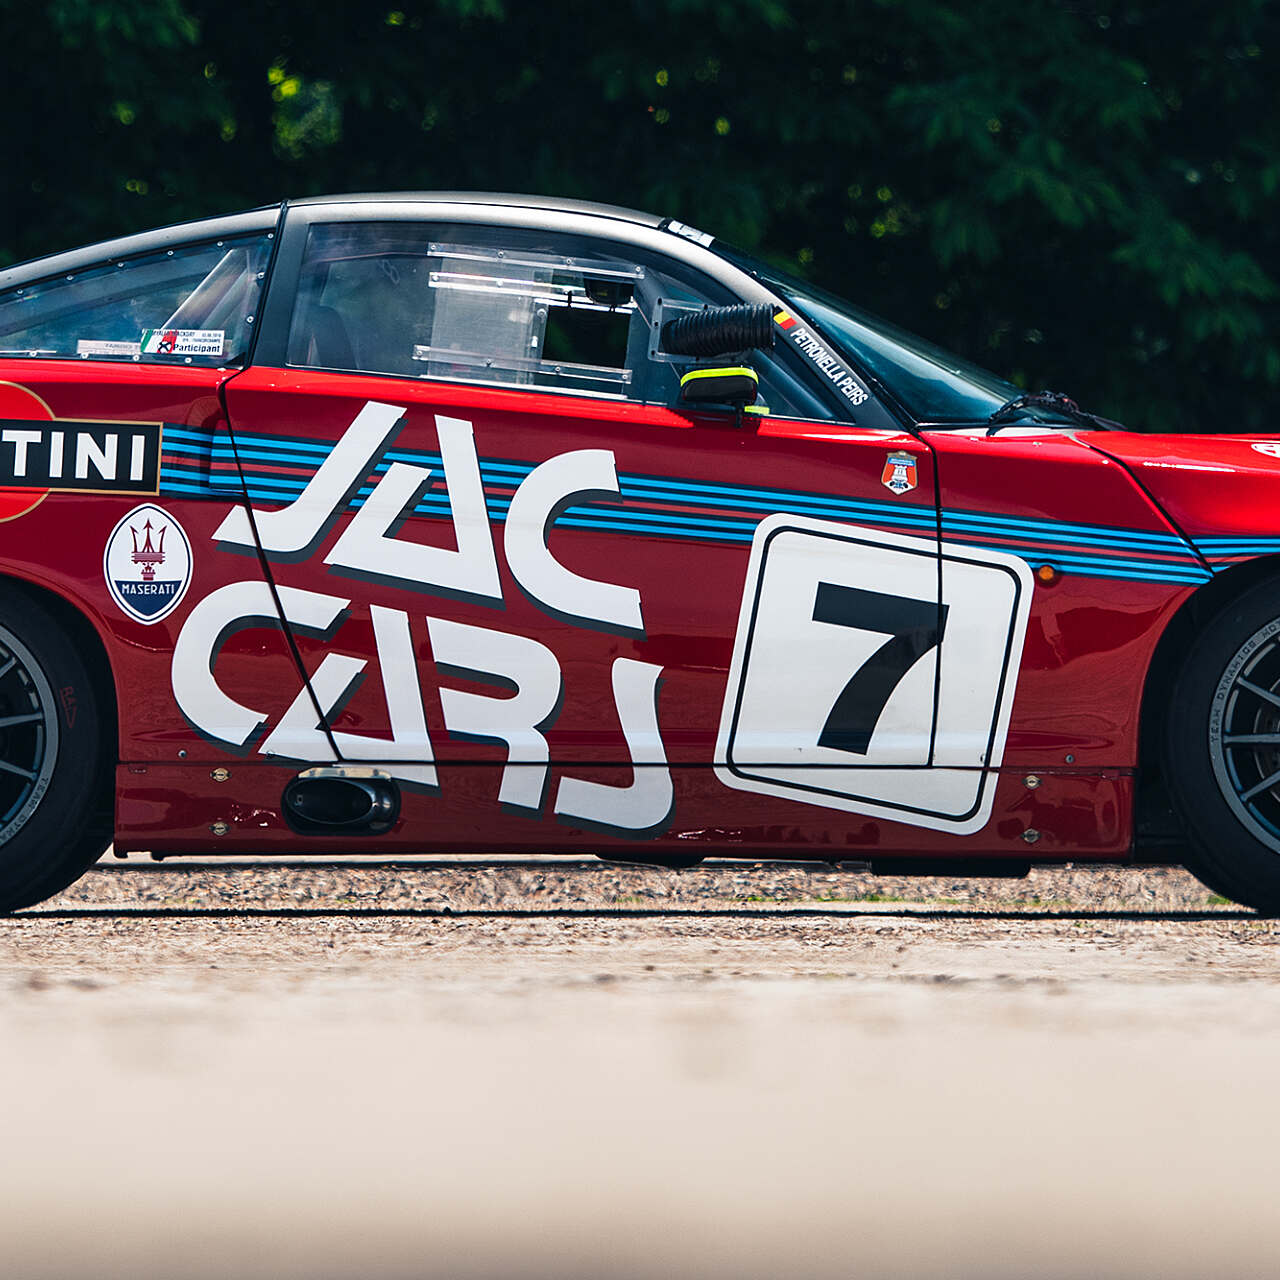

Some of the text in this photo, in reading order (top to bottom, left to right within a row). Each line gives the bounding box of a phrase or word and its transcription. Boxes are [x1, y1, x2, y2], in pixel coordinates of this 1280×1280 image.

[173, 344, 220, 353] Participant
[790, 328, 868, 406] PETRONELLA PEIRS
[211, 400, 646, 633] JAC
[121, 584, 175, 595] MASERATI
[171, 580, 675, 831] CARS
[812, 581, 950, 755] 7
[1217, 640, 1256, 700] DYNAMICS
